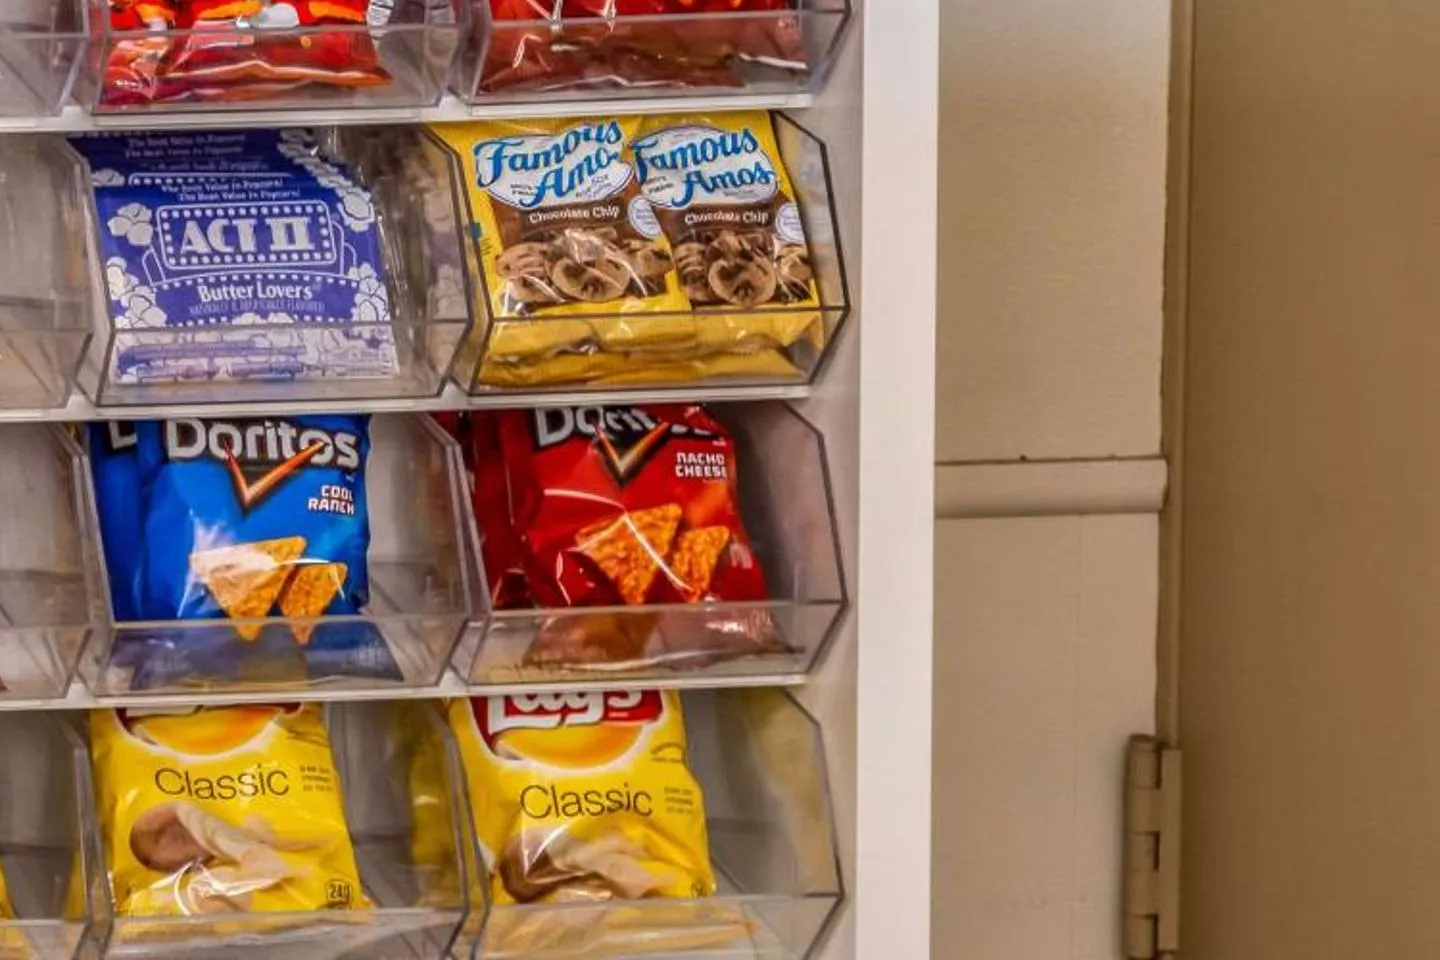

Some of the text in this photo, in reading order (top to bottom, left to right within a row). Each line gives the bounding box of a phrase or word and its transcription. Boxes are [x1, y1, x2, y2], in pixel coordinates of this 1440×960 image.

[474, 121, 623, 187] Famous
[631, 128, 759, 185] Famous
[671, 161, 775, 207] Amos
[529, 203, 621, 224] Chocolate Chip
[684, 211, 769, 225] Chocolate Chip
[180, 216, 315, 254] ACT II
[197, 282, 313, 303] Butter Lovers
[166, 418, 359, 469] Doritos
[676, 452, 725, 465] NACHO
[308, 497, 355, 515] RANCH
[154, 763, 290, 801] Classic
[520, 782, 653, 820] Classic
